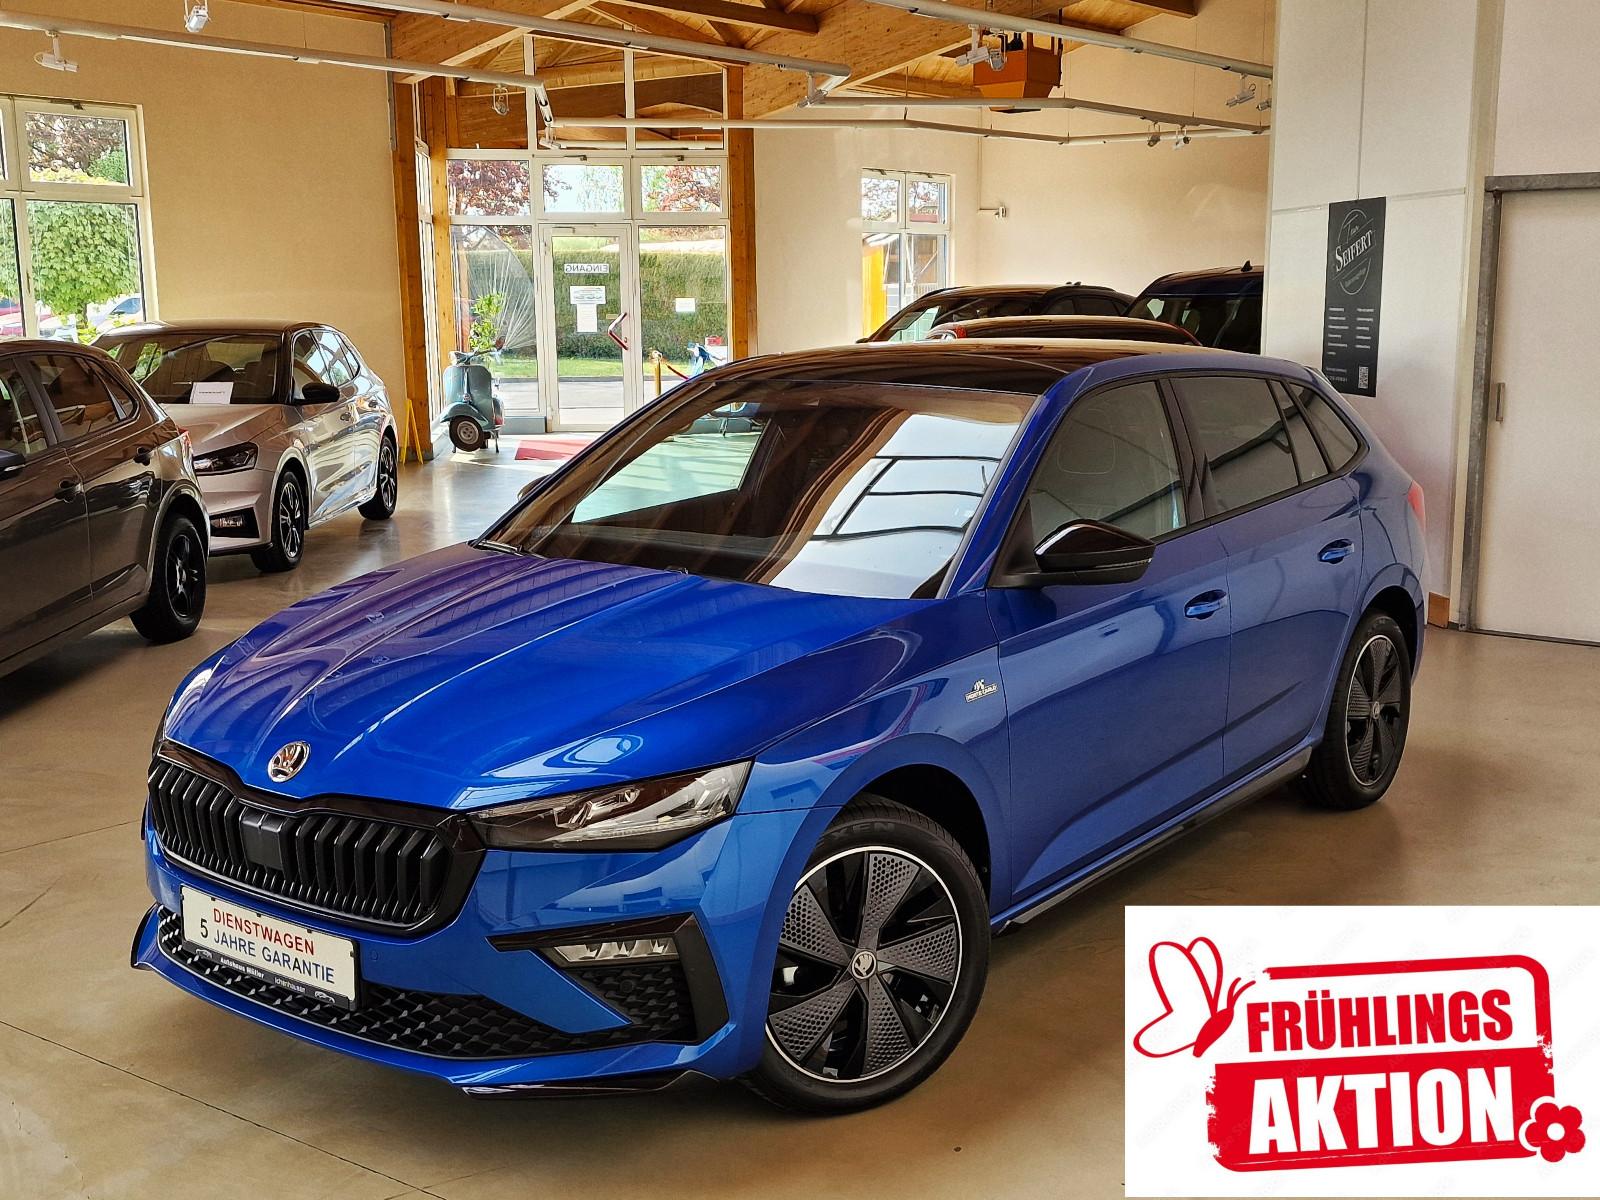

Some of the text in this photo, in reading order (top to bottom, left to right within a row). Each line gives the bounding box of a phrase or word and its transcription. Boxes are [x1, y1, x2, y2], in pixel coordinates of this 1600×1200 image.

[1335, 230, 1373, 272] SEIFERT
[200, 918, 335, 984] 5 JAHRE GARANTIE
[213, 908, 314, 956] DIENSTWAGEN
